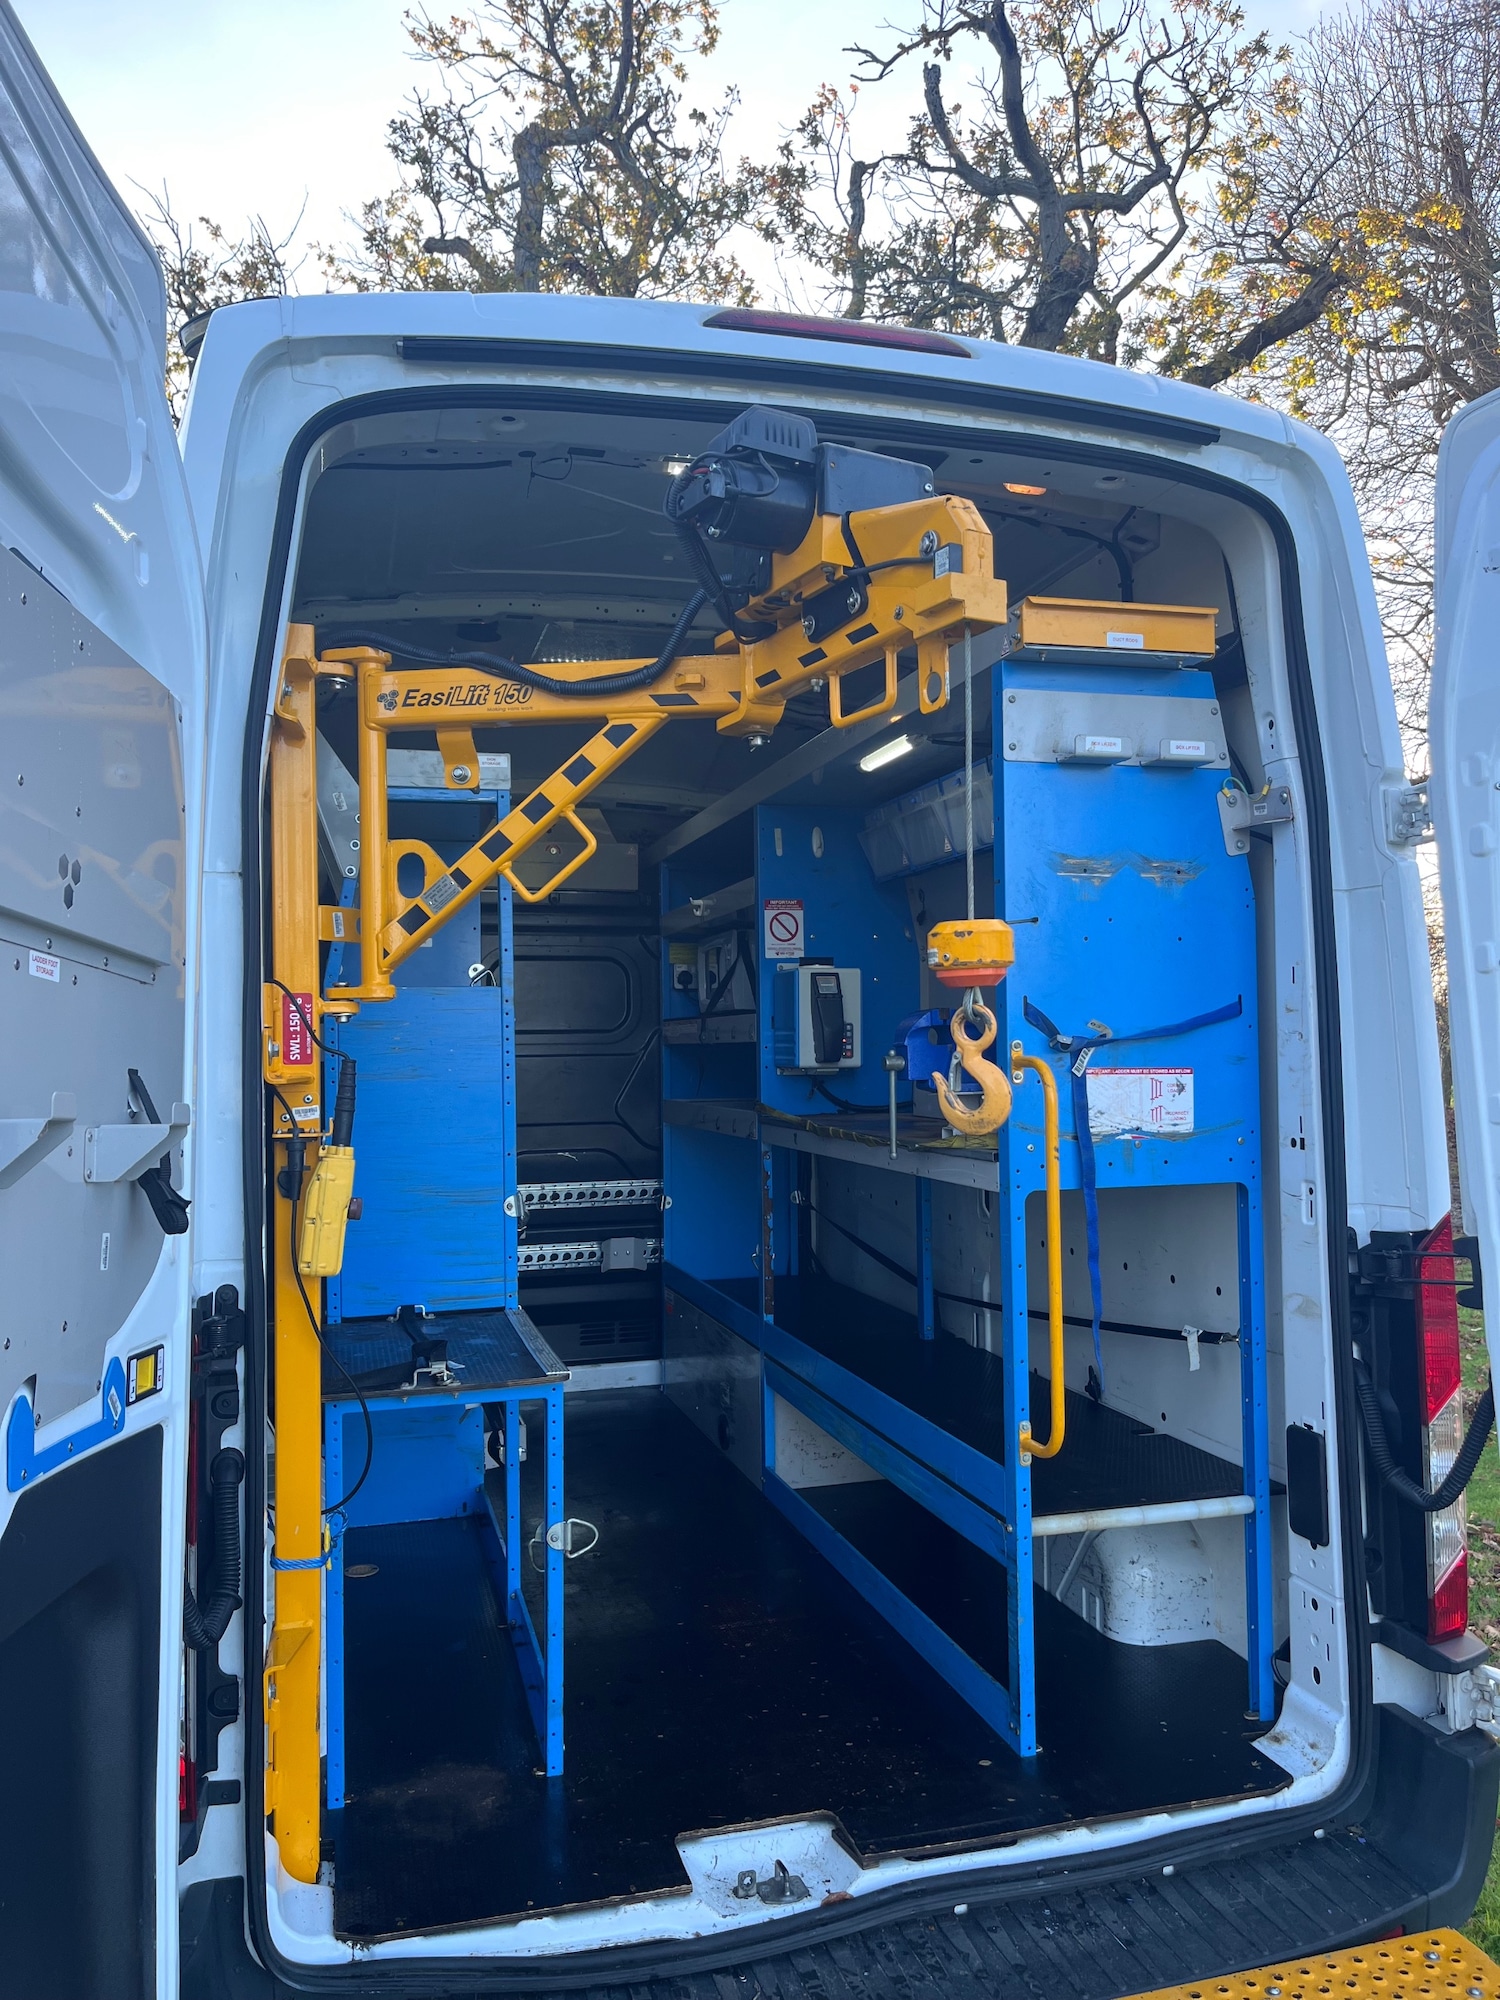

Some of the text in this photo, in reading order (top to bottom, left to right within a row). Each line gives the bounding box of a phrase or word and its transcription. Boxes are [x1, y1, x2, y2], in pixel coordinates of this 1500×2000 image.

[402, 683, 534, 707] EasiLift 150
[32, 954, 58, 968] LADDER FOOT
[36, 965, 54, 977] STORAGE
[290, 1012, 300, 1032] 150
[290, 1034, 300, 1060] SWL:
